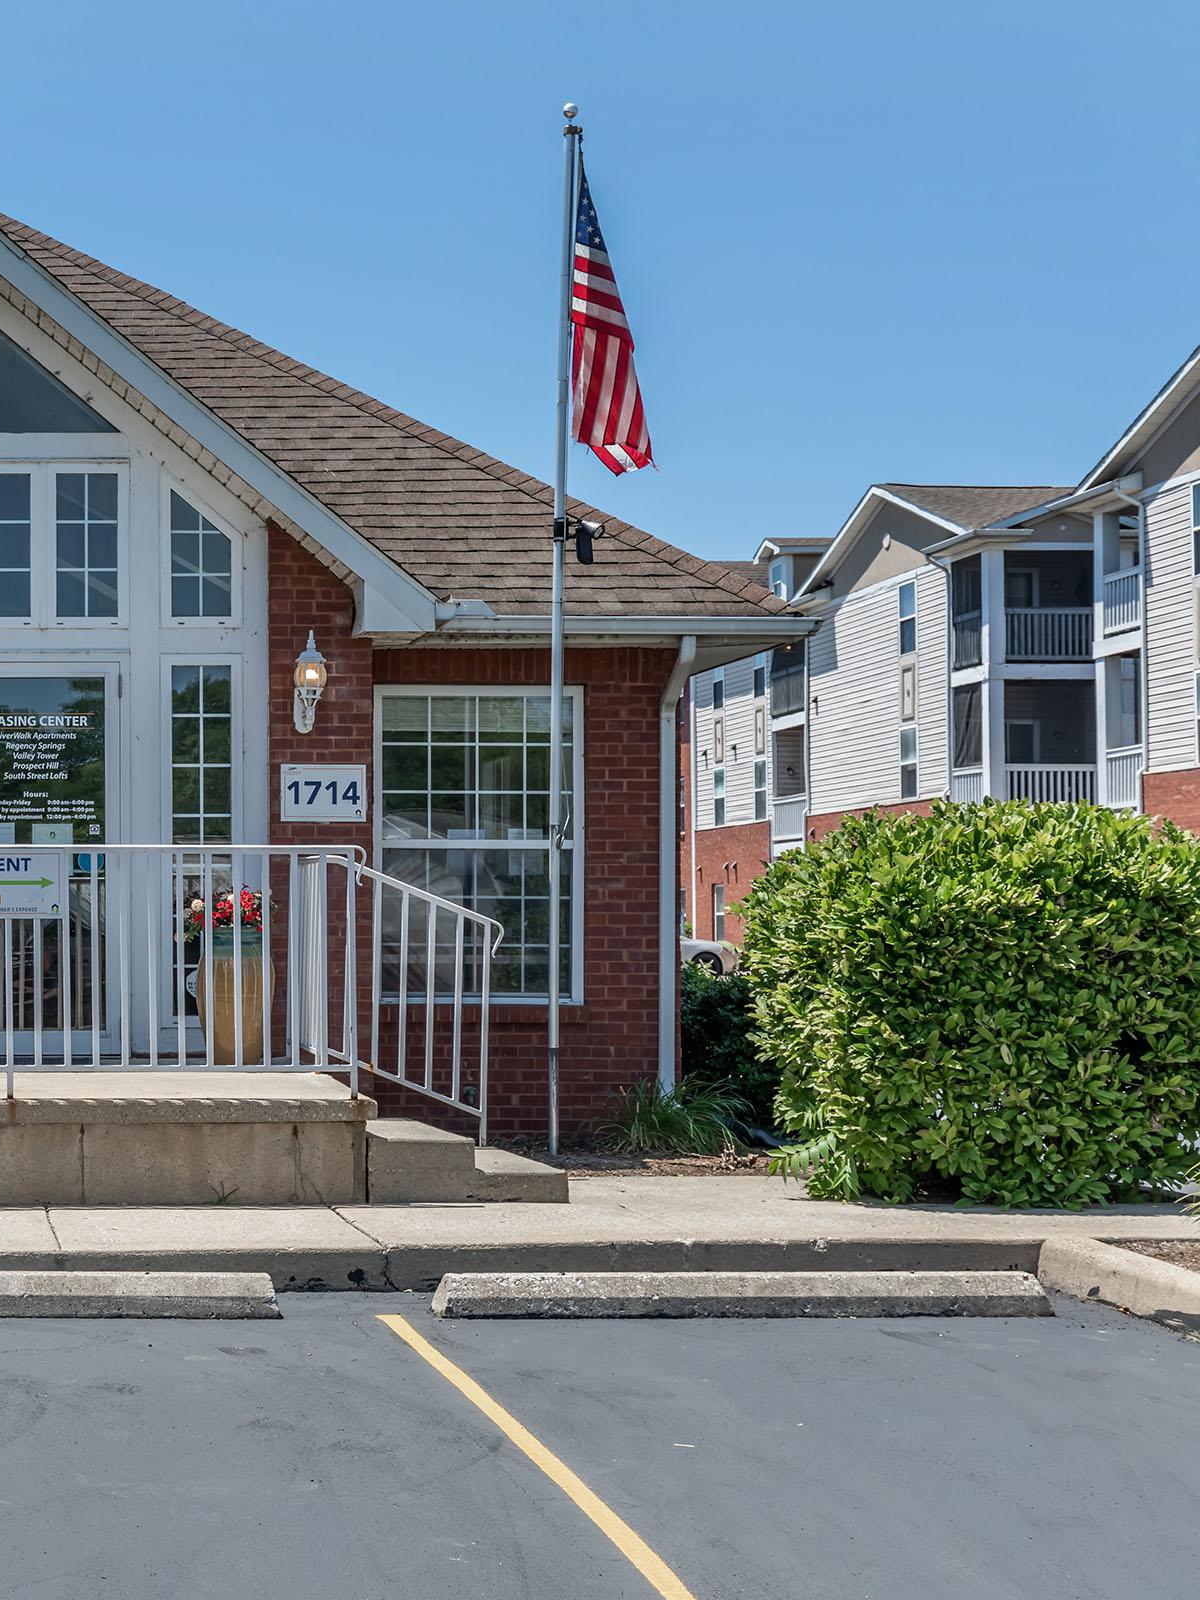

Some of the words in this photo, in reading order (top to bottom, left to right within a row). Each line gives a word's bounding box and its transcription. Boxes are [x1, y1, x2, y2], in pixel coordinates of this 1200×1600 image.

[39, 716, 88, 727] CENTER
[32, 732, 77, 740] Apartments
[5, 742, 37, 751] Regency
[38, 742, 66, 751] Springs
[13, 752, 36, 761] Valley
[12, 762, 46, 770] Prospect
[49, 771, 68, 779] Lofts
[287, 781, 360, 805] 1714
